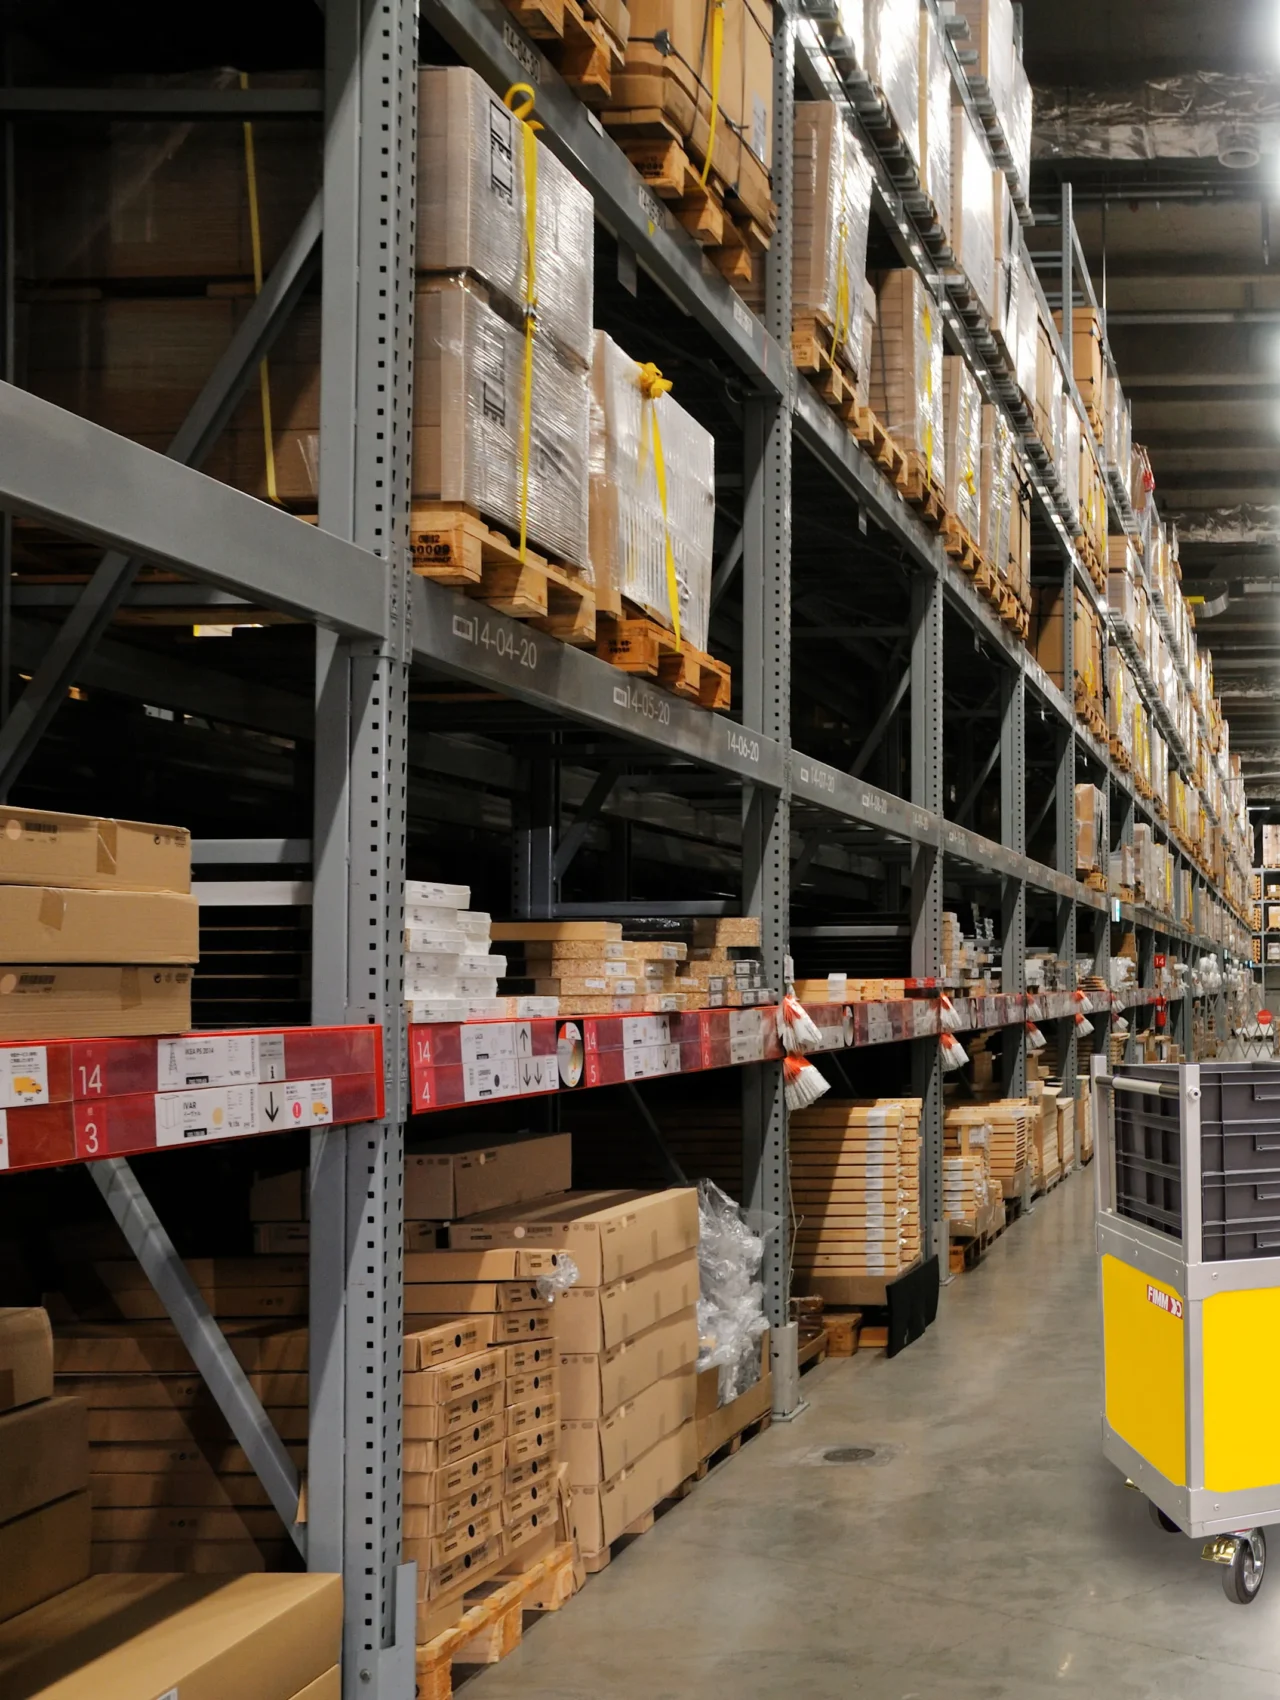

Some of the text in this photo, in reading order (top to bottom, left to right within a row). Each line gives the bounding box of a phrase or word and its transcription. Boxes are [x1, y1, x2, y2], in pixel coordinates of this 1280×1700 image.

[505, 24, 539, 82] 14-04-30
[472, 616, 538, 670] 14-04-20
[626, 685, 671, 726] 14-05-20
[727, 730, 760, 763] 14-06-20
[417, 1040, 431, 1064] 14
[586, 1034, 597, 1051] 14
[79, 1064, 103, 1096] 14
[590, 1065, 596, 1083] 5
[183, 1101, 197, 1110] IVAR
[422, 1081, 431, 1104] 4
[84, 1122, 99, 1154] 3
[1148, 1285, 1169, 1312] FIMM
